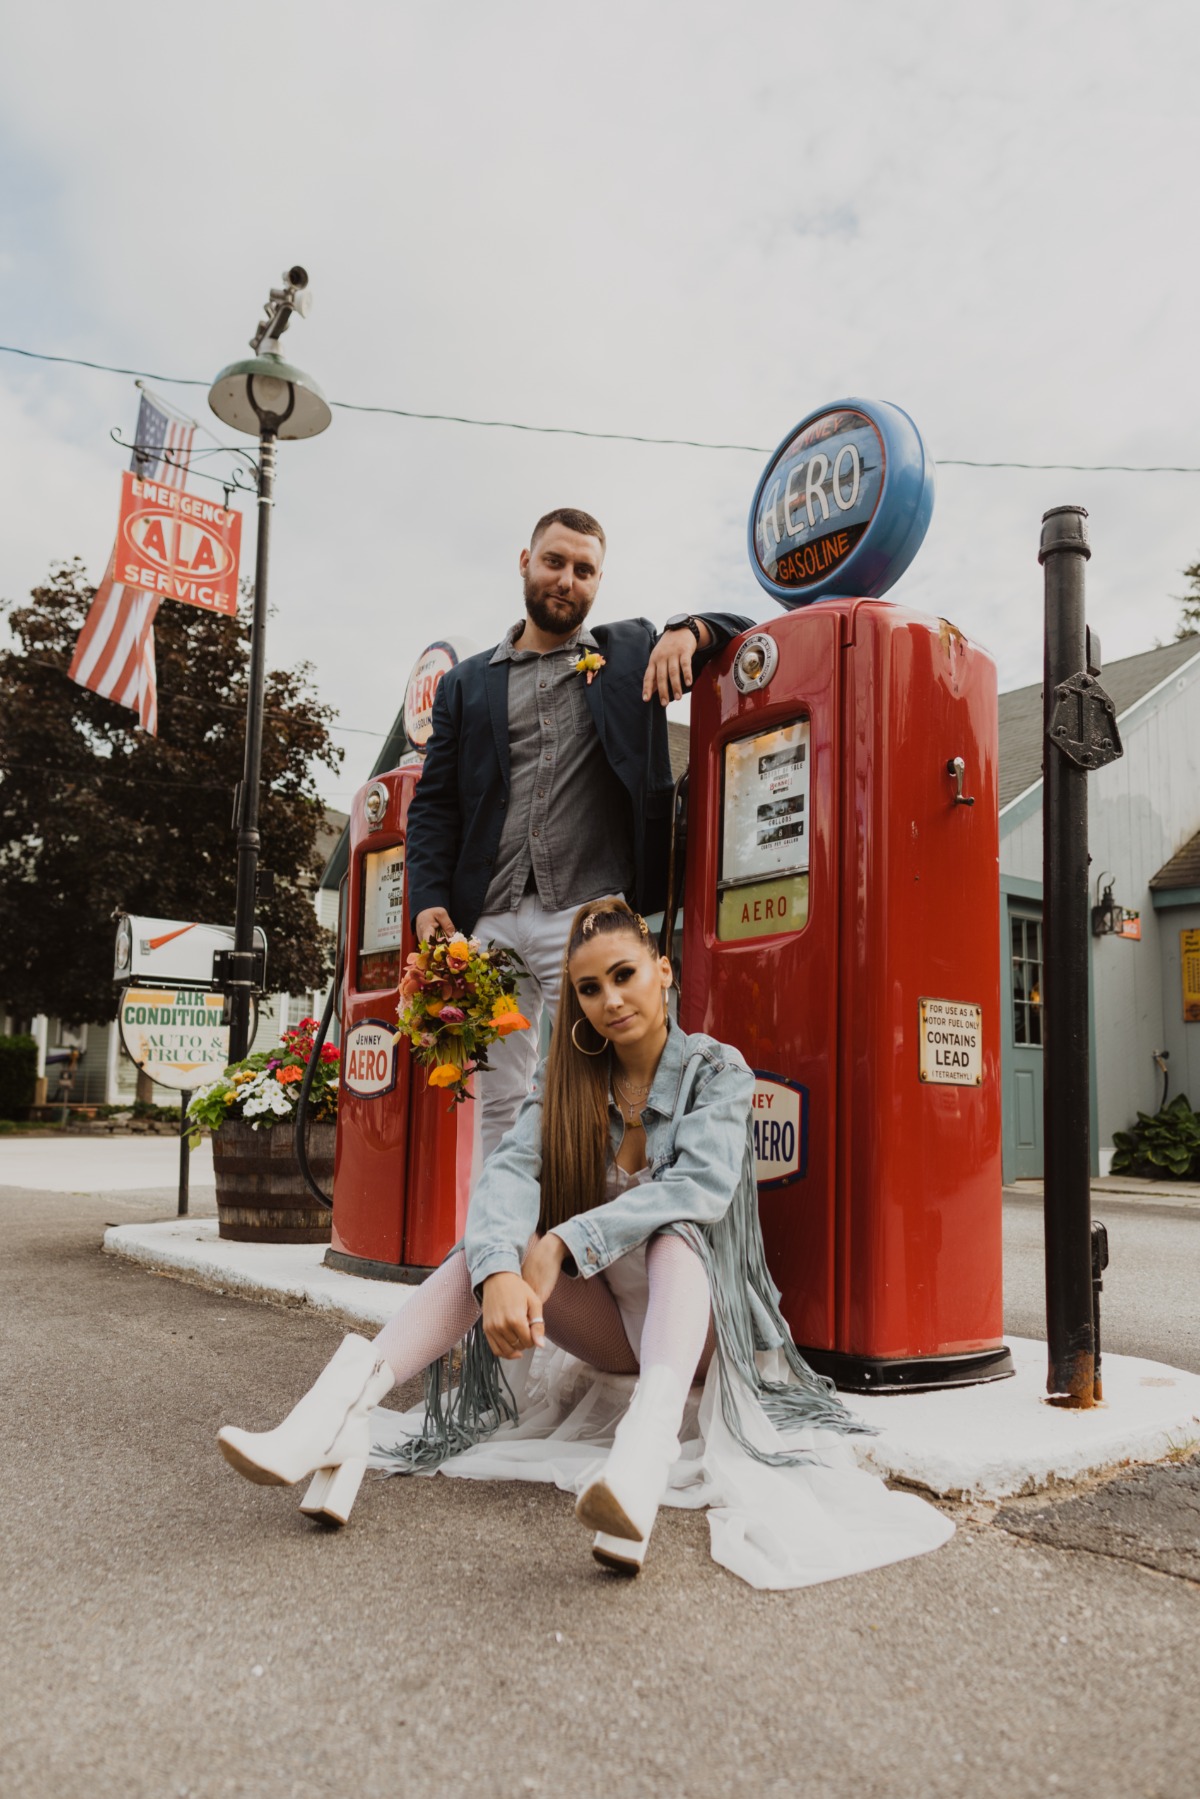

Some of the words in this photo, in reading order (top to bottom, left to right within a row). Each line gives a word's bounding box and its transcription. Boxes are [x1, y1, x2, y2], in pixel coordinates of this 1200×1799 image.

[131, 478, 236, 528] EMERGENCY
[762, 443, 861, 550] AERO
[142, 519, 217, 571] ALA
[778, 532, 850, 581] GASOLINE
[124, 564, 230, 610] SERVICE
[413, 716, 432, 733] GASOLIN
[741, 896, 788, 923] AERO
[175, 991, 205, 1006] AIR
[929, 1004, 943, 1014] FOR
[945, 1006, 958, 1016] USE
[959, 1008, 968, 1018] AS
[969, 1009, 974, 1018] A
[922, 1016, 946, 1027] MOTOR
[948, 1018, 964, 1029] FUEL
[965, 1020, 980, 1030] ONLY
[149, 1034, 202, 1047] AUTO
[210, 1036, 223, 1049] &
[355, 1033, 381, 1045] JENNEY
[927, 1031, 976, 1048] CONTAINS
[147, 1049, 229, 1063] TRUCKS
[347, 1049, 387, 1081] AERO
[935, 1049, 969, 1067] LEAD
[754, 1120, 795, 1163] AERO
